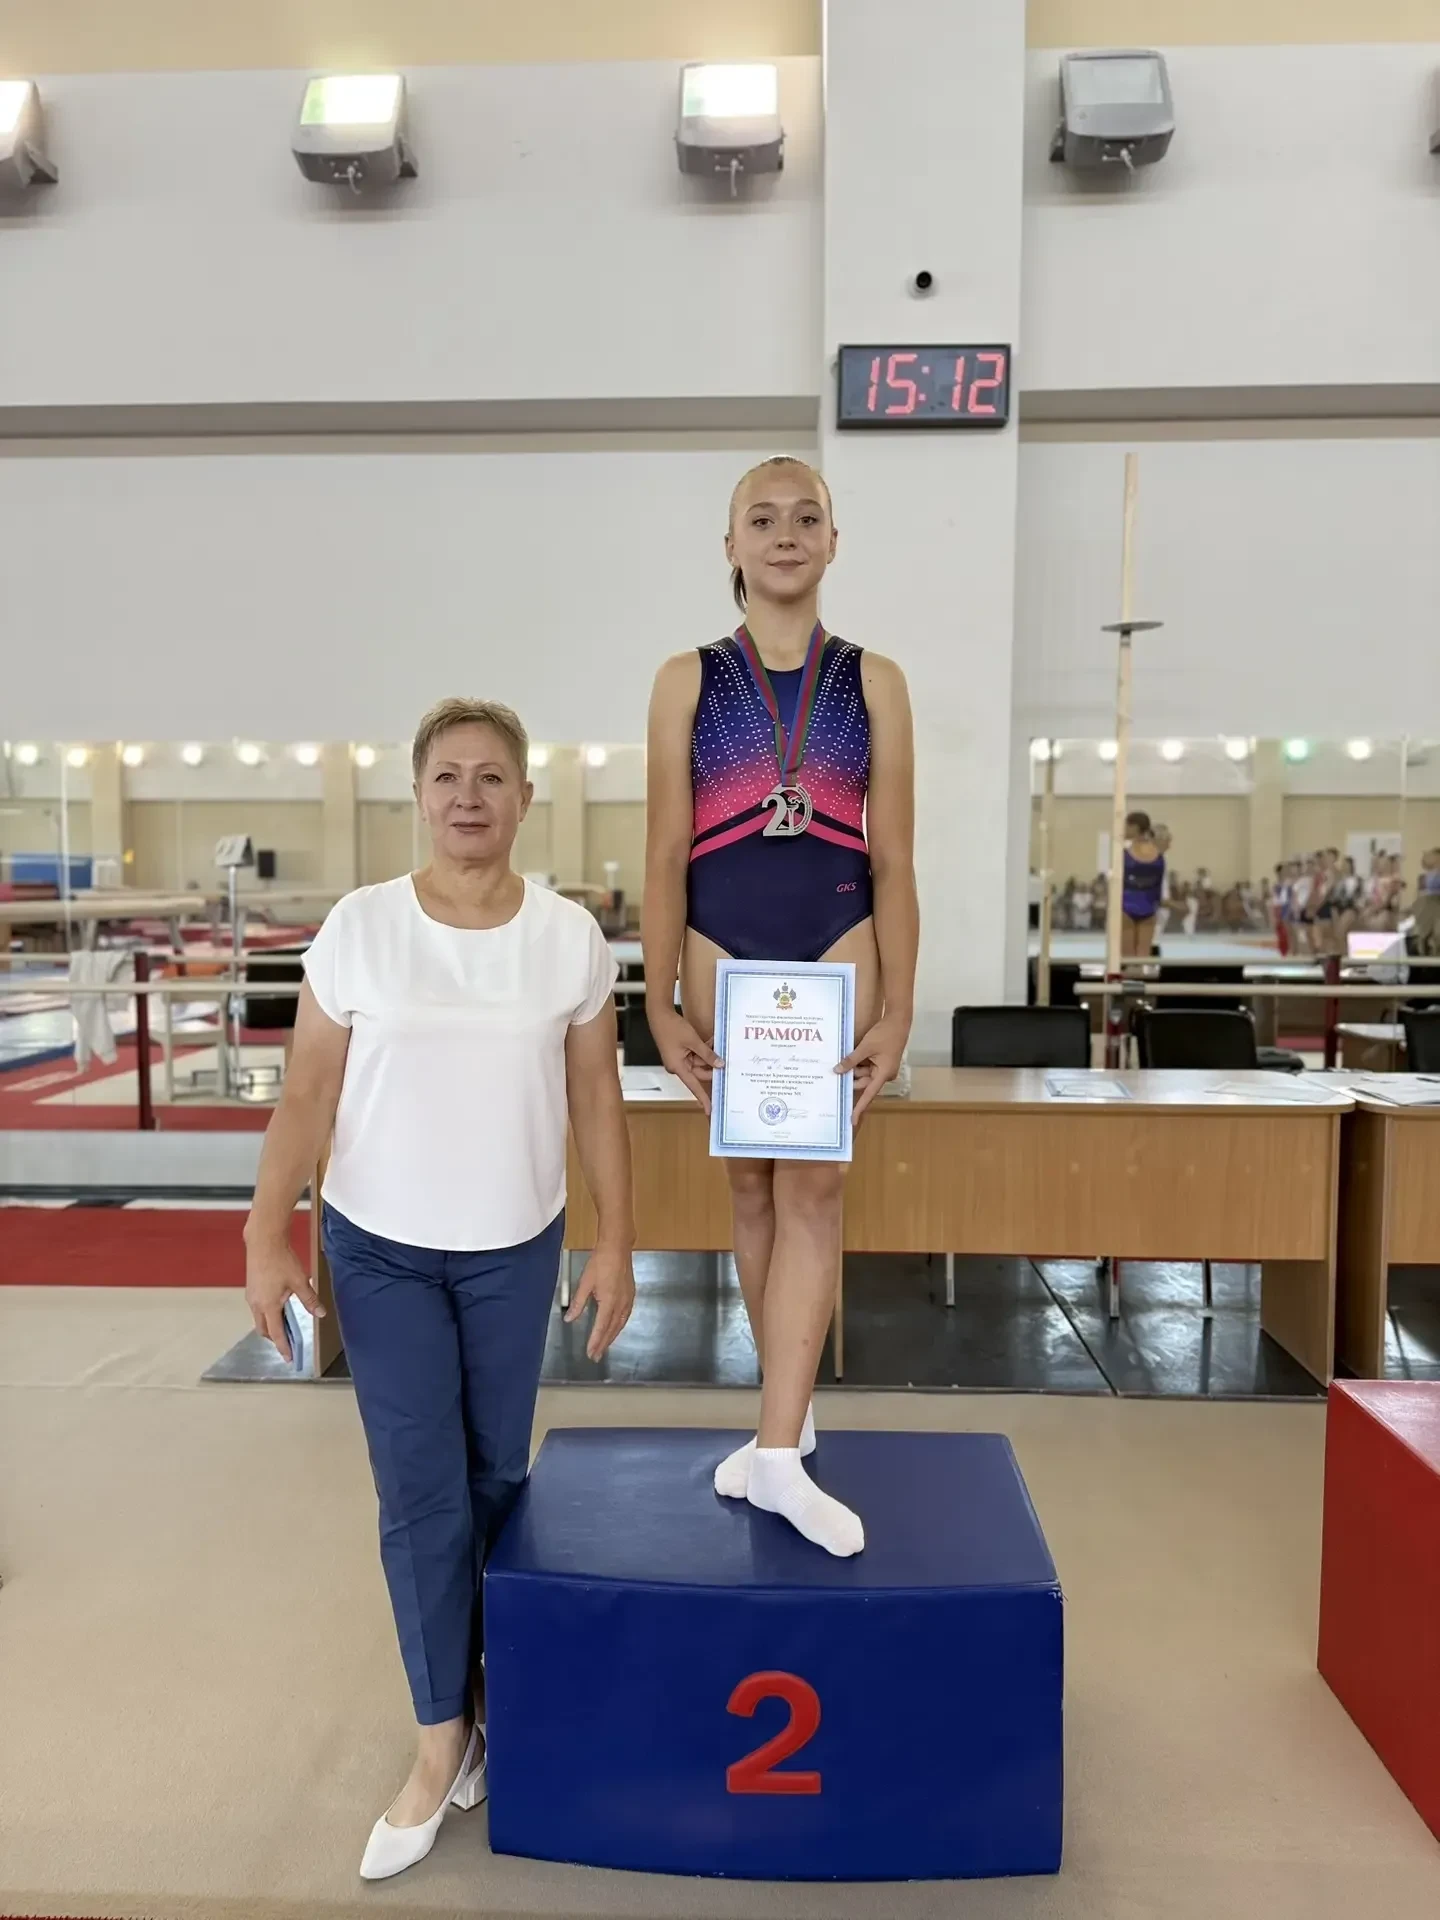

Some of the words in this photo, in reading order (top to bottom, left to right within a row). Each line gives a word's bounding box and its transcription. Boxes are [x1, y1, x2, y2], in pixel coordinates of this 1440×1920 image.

[867, 353, 1005, 414] 15:12
[836, 881, 857, 893] GKS
[744, 1026, 823, 1042] ГРАМОТА
[726, 1670, 821, 1794] 2
